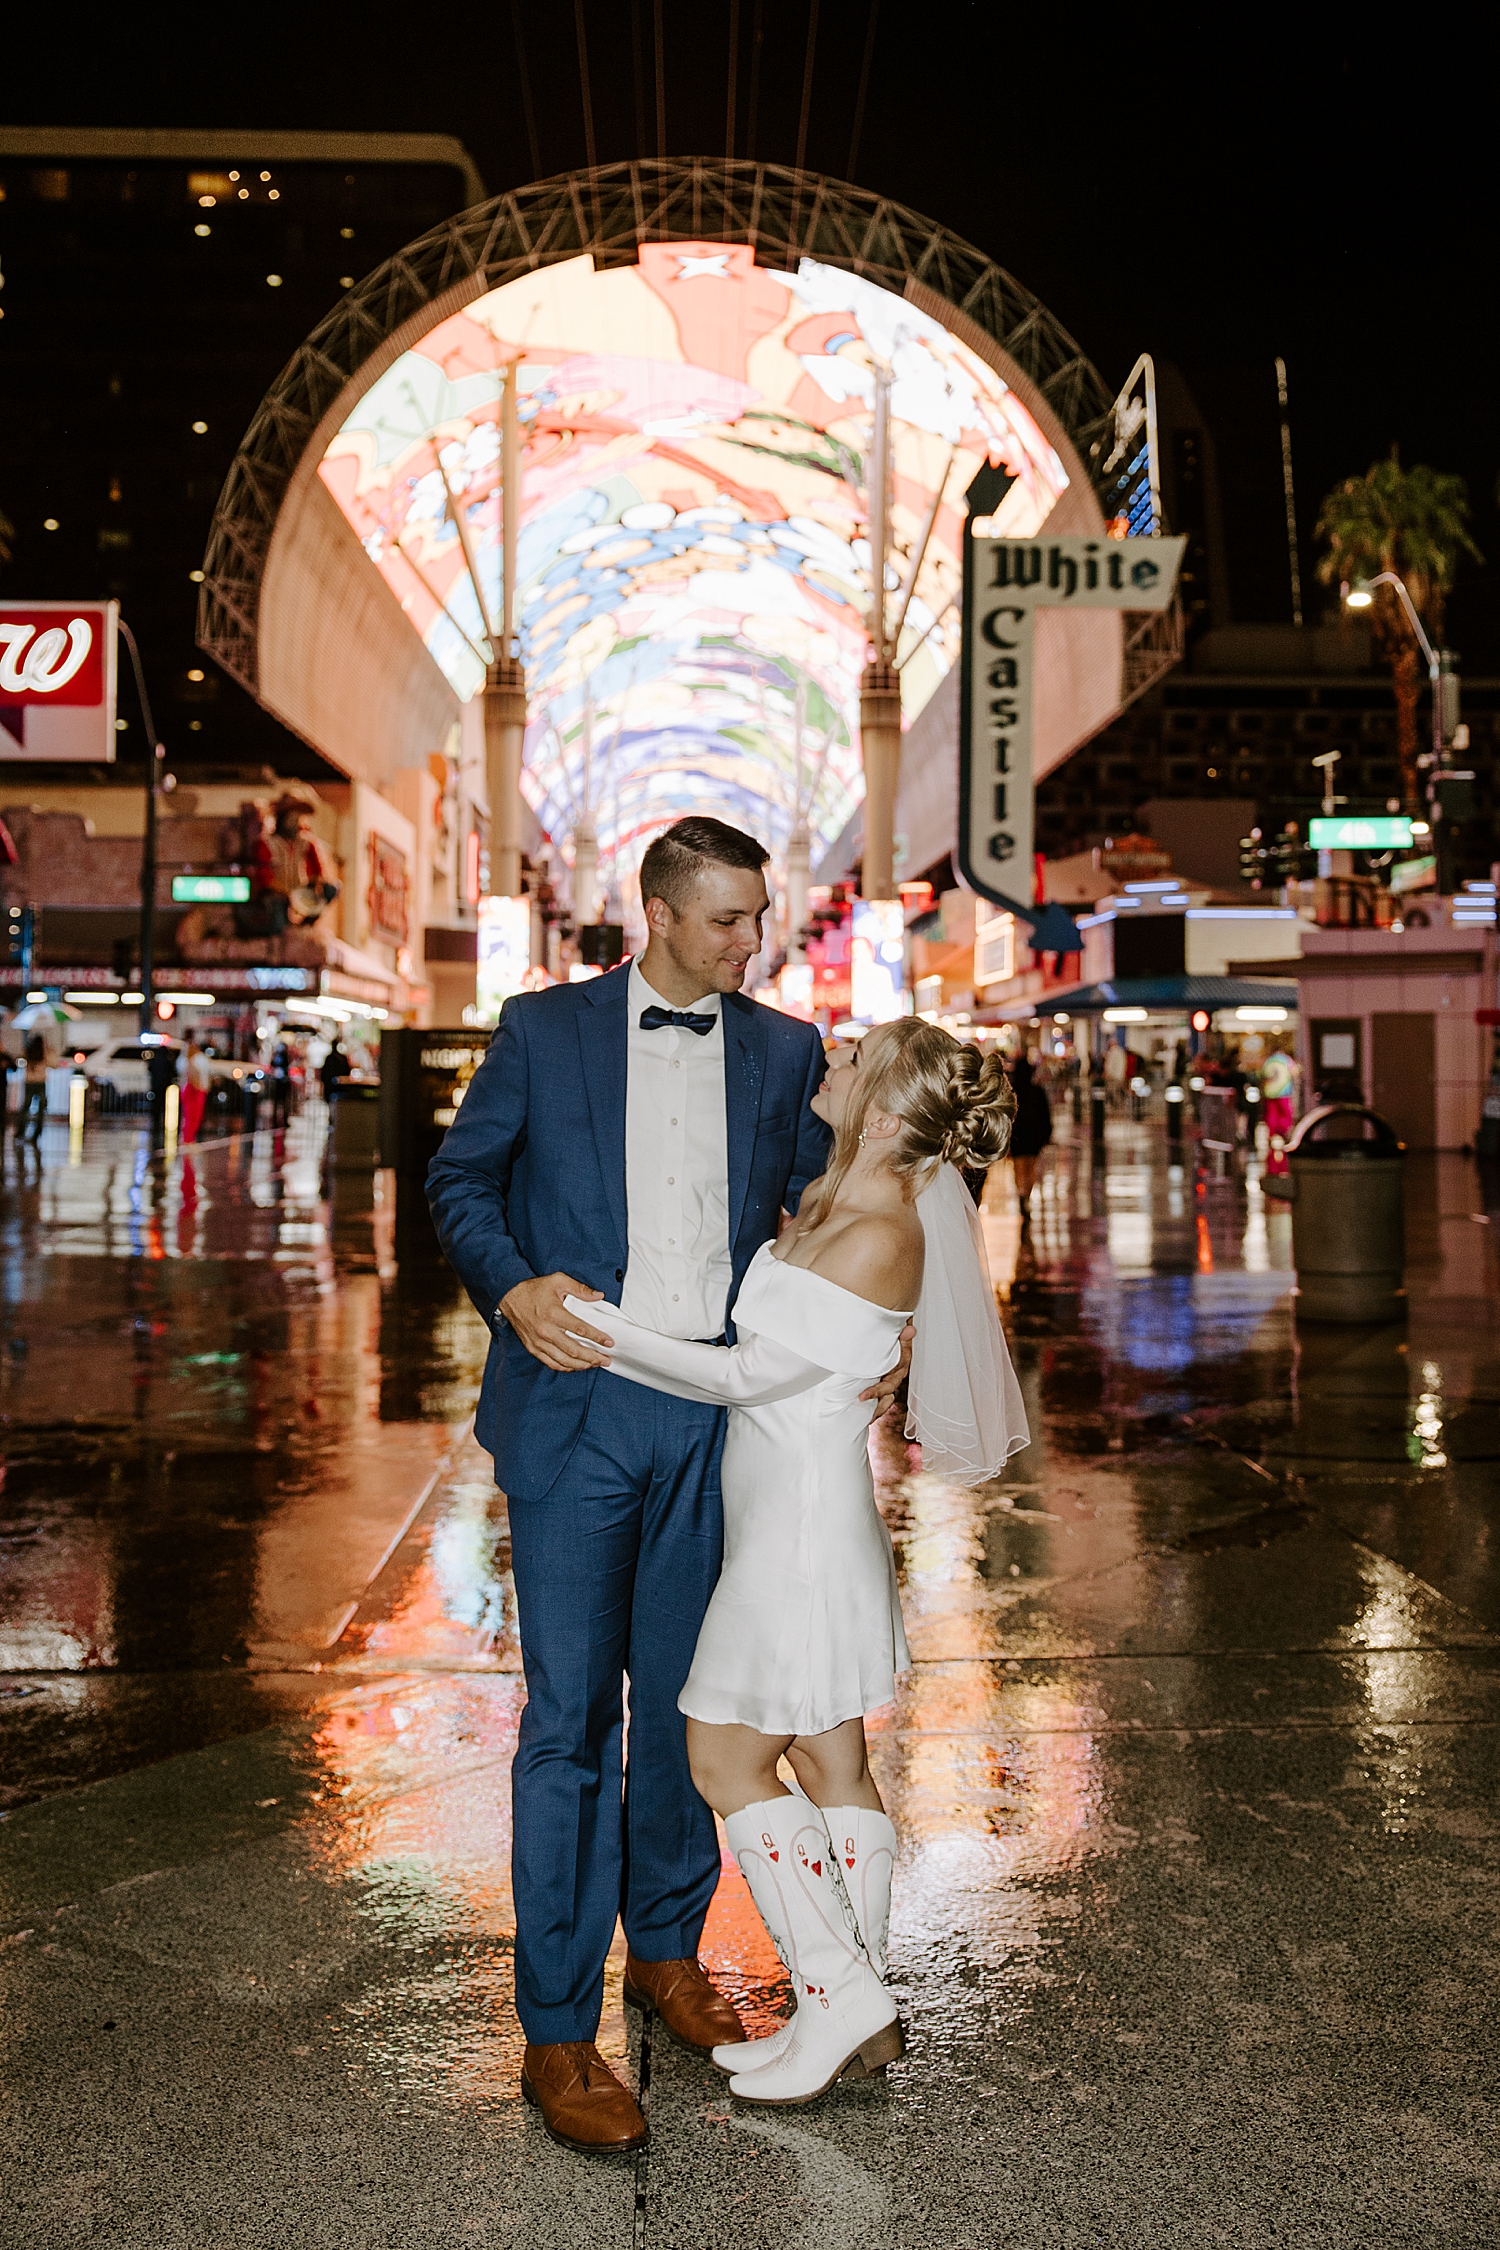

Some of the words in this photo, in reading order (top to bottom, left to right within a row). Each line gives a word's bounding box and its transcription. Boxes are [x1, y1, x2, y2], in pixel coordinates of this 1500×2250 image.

[988, 543, 1158, 597] White
[981, 605, 1025, 862] Castle
[761, 1832, 776, 1849] Q
[845, 1838, 856, 1854] Q
[797, 1844, 806, 1857] Q
